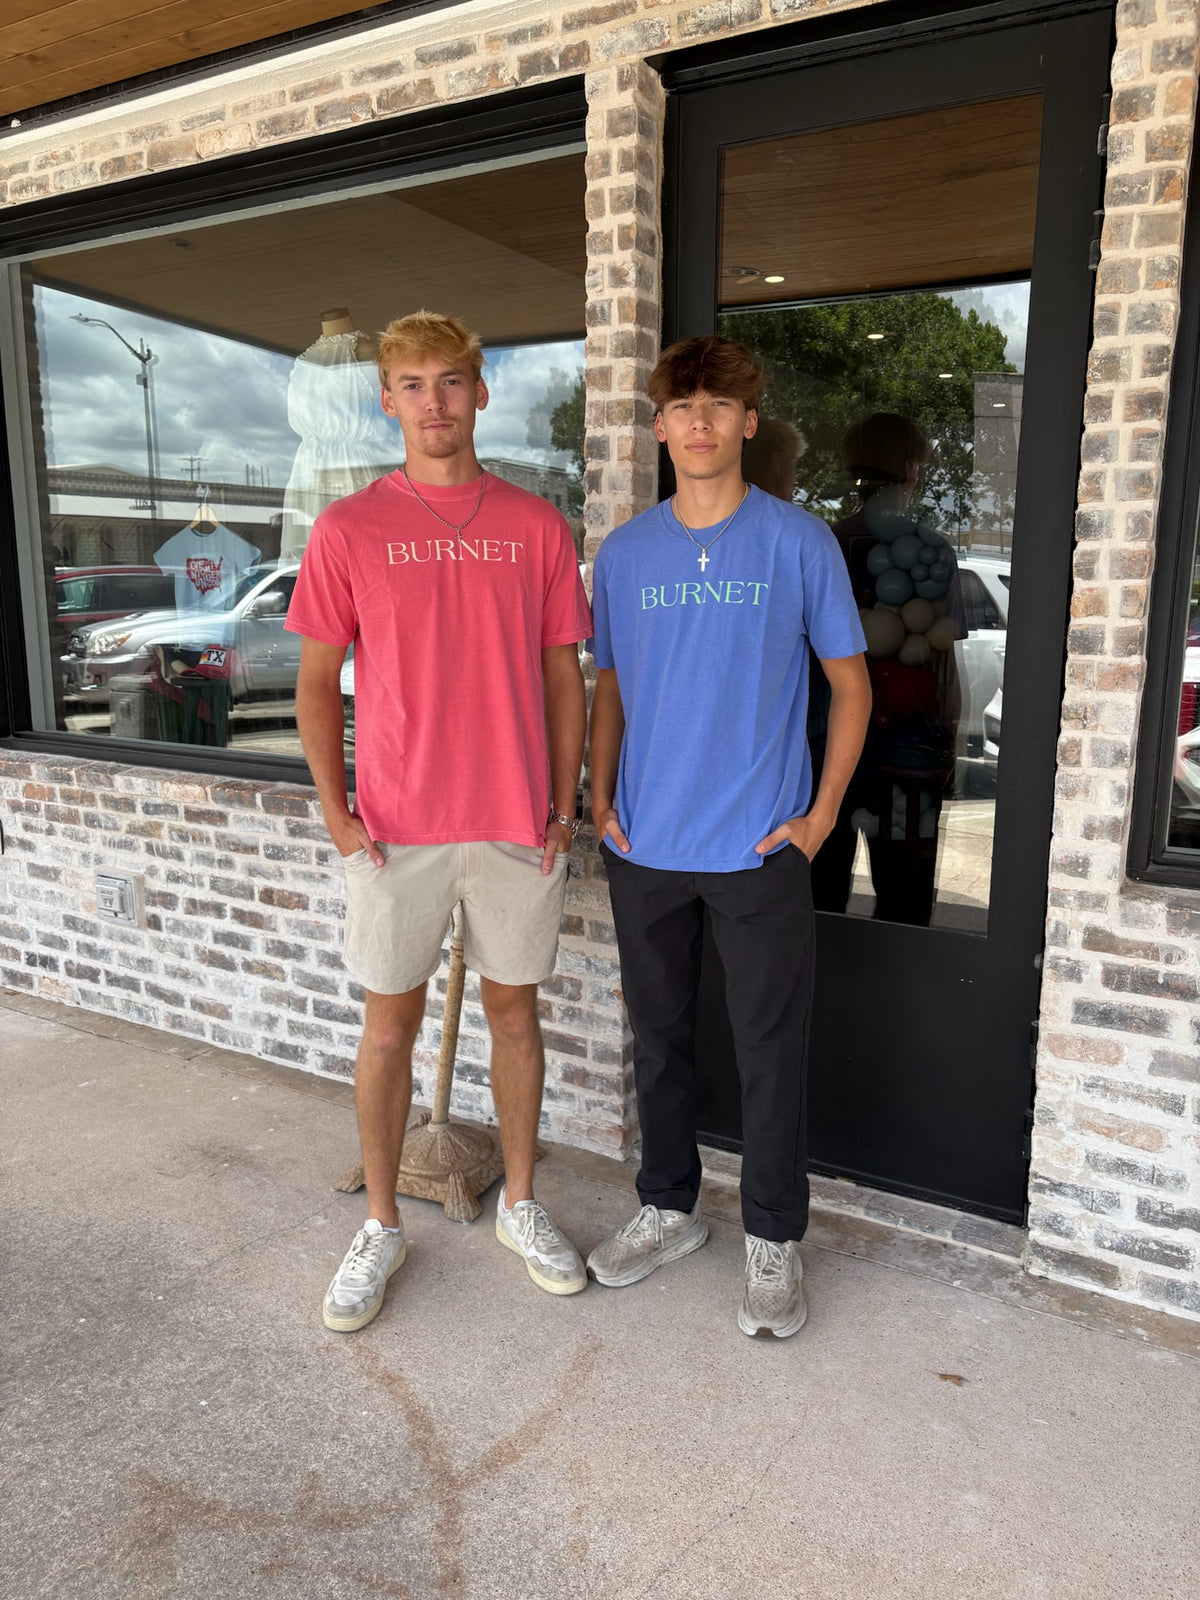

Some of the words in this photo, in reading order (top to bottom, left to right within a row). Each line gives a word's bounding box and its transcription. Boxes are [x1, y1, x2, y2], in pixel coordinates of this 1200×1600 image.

[387, 539, 524, 565] BURNET
[641, 581, 769, 610] BURNET
[207, 650, 225, 663] TX
